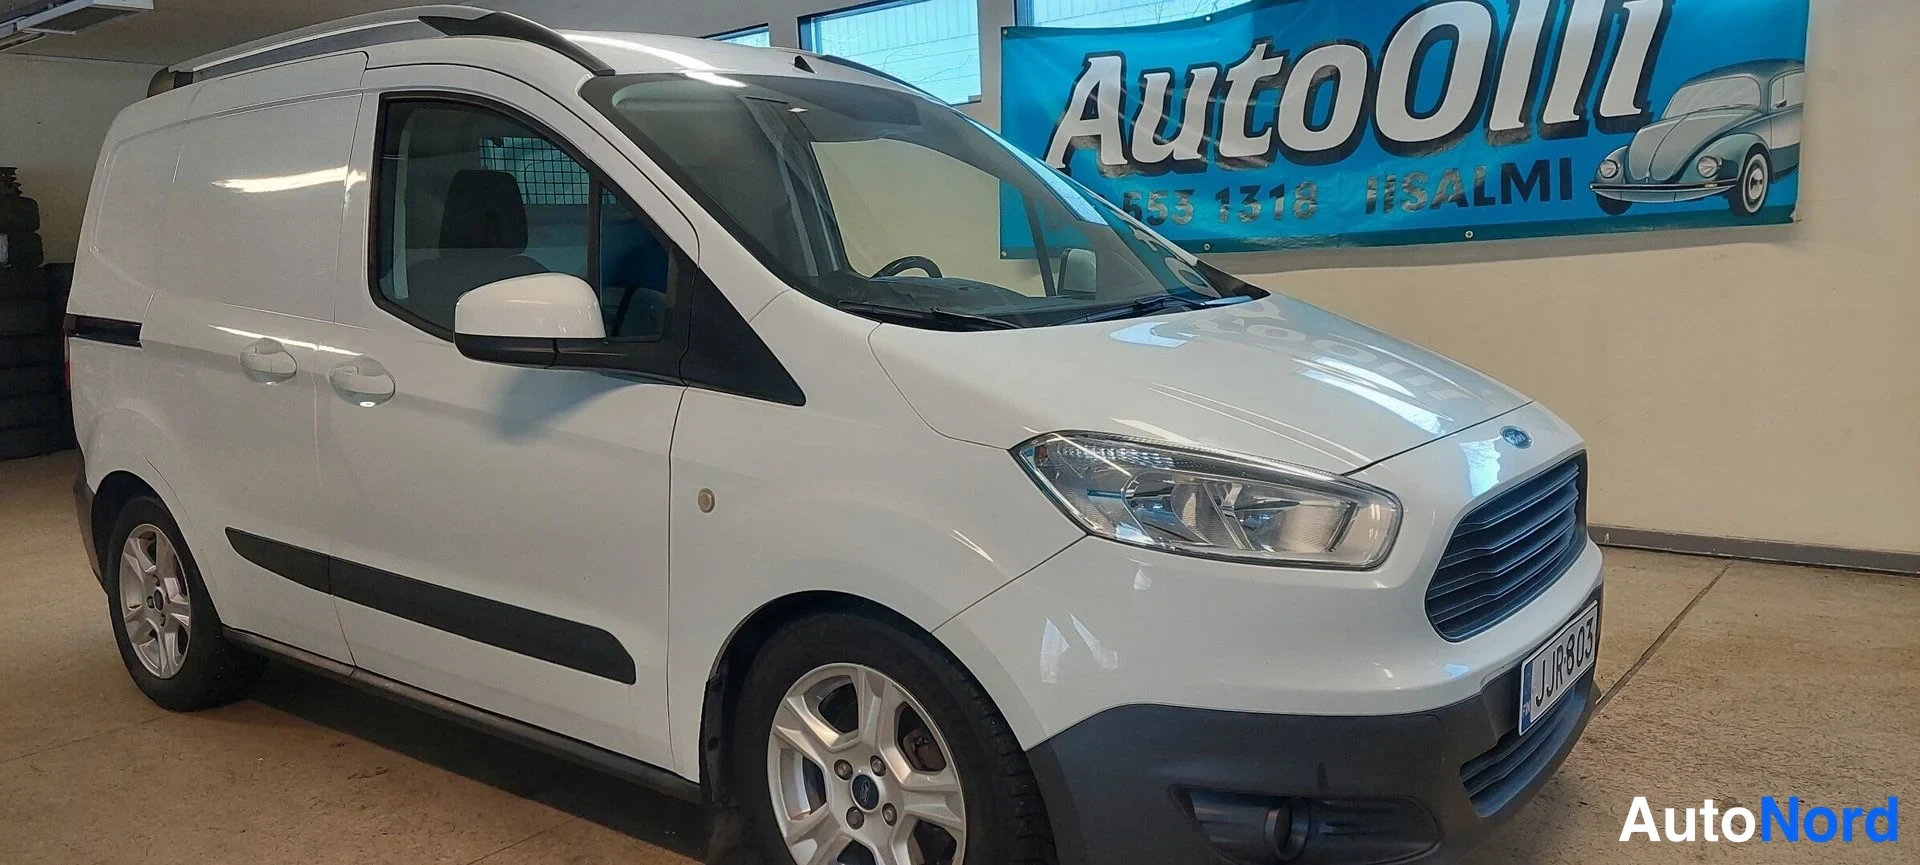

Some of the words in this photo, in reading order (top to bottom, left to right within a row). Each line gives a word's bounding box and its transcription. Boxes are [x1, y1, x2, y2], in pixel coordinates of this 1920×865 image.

[1044, 0, 1666, 170] AutoOlli
[1215, 180, 1318, 224] 1318
[1365, 157, 1573, 215] IISALMI
[1535, 616, 1594, 708] JJR-803
